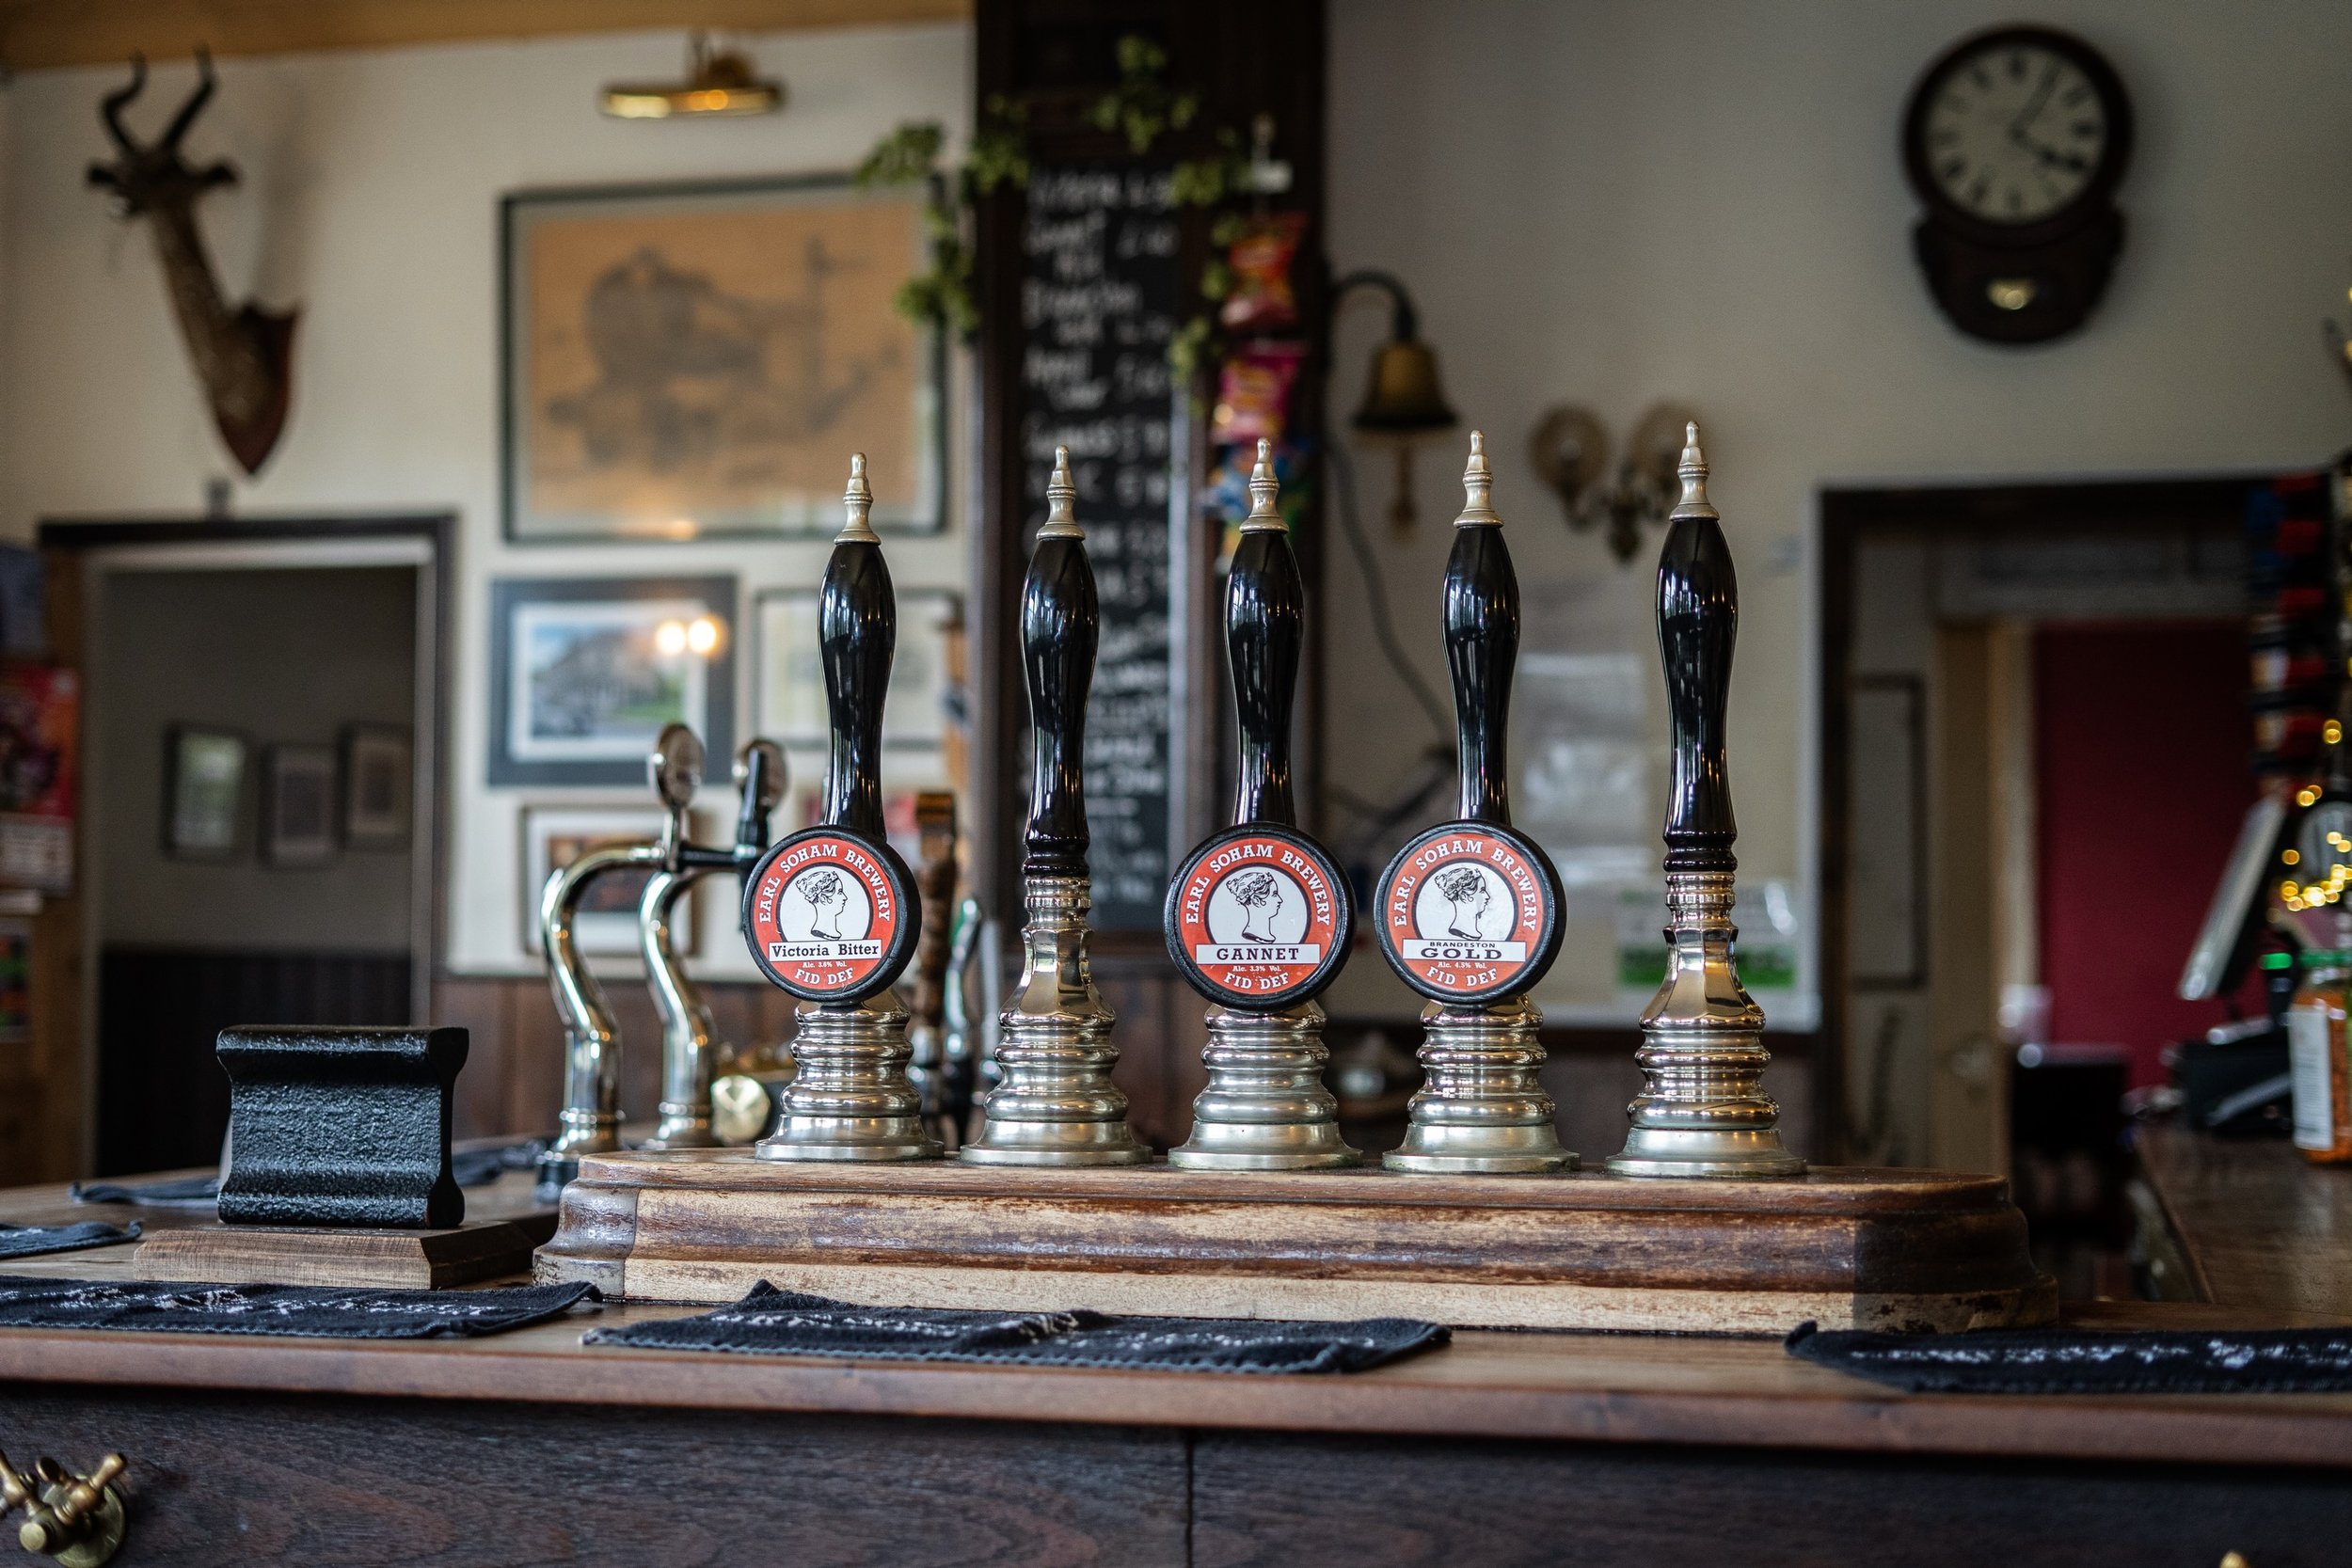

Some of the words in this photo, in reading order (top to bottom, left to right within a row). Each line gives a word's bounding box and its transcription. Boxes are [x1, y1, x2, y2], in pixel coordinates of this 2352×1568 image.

[759, 876, 782, 923] EARL
[780, 844, 837, 874] SOHAM
[844, 848, 890, 922] BREWERY
[1185, 875, 1210, 924] EARL
[1209, 844, 1274, 874] SOHAM
[1279, 849, 1330, 926] BREWERY
[1393, 875, 1416, 927] EARL
[1415, 839, 1483, 871] SOHAM
[1490, 847, 1537, 931] BREWERY
[771, 944, 830, 958] Victoria
[837, 943, 879, 956] Bitter
[1216, 948, 1299, 960] GANNET
[1421, 947, 1502, 959] GOLD
[794, 969, 820, 985] FID
[827, 967, 854, 985] DEF
[1223, 972, 1252, 989] FID
[1260, 973, 1289, 990] DEF
[1426, 966, 1456, 985] FID
[1466, 968, 1497, 987] DEF
